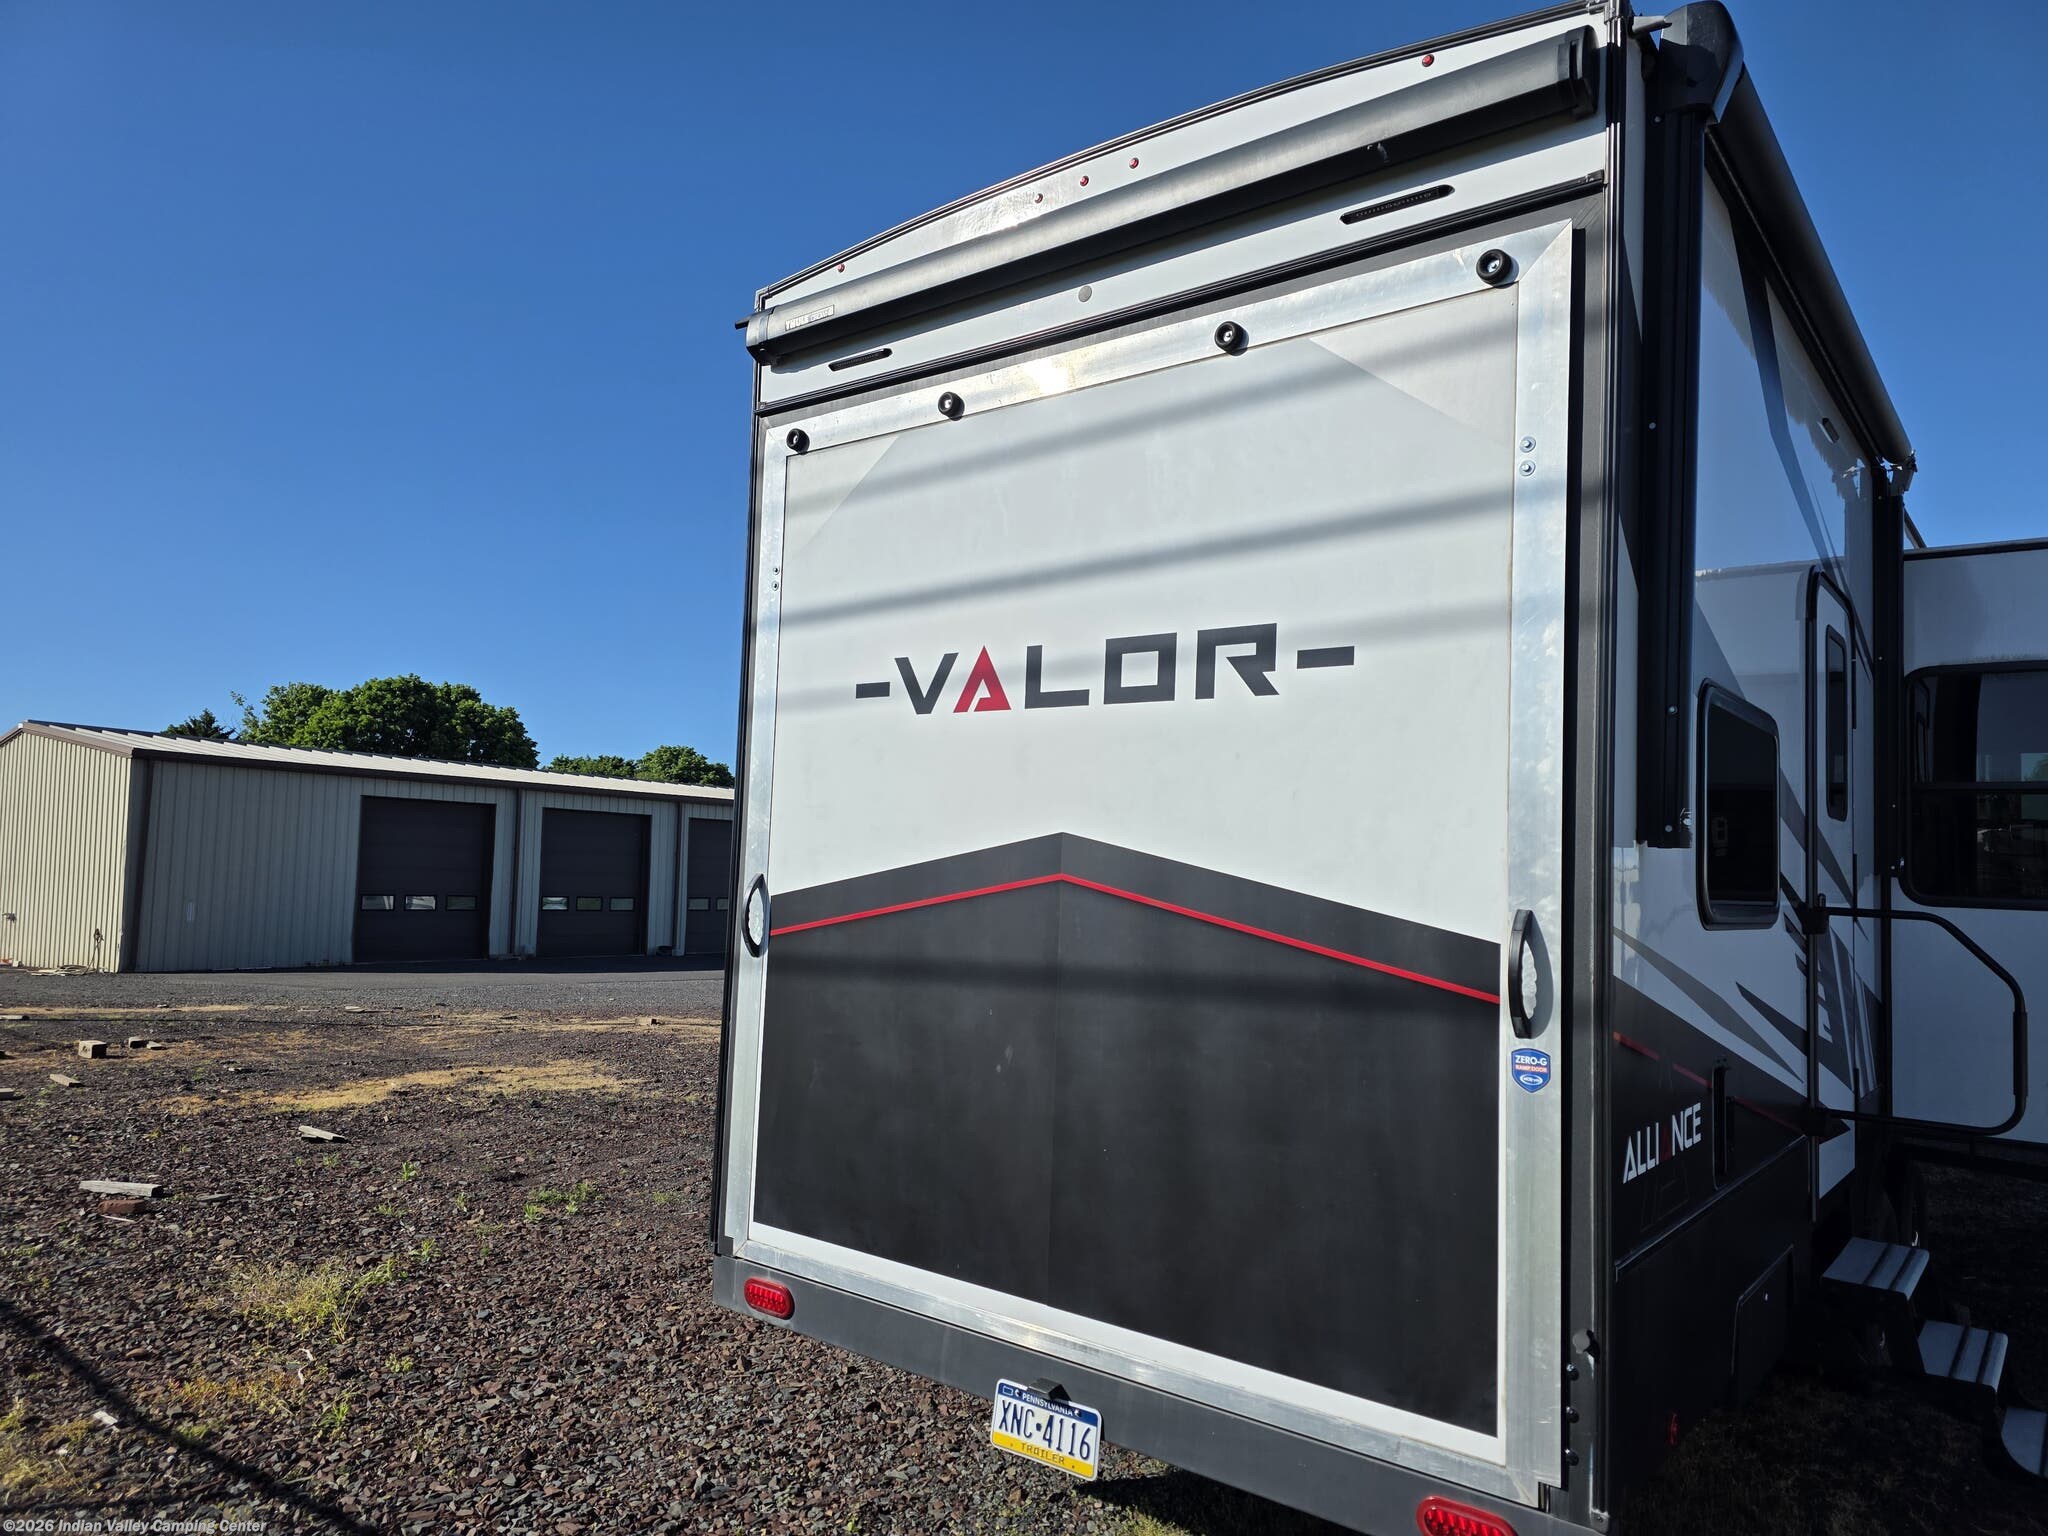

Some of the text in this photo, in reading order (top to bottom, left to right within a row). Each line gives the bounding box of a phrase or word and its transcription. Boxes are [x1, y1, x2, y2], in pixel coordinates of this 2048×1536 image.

[1515, 1055, 1547, 1066] ZERO-G
[1022, 1393, 1074, 1417] PENNSYLVANIA
[1021, 1443, 1065, 1465] TRAILER
